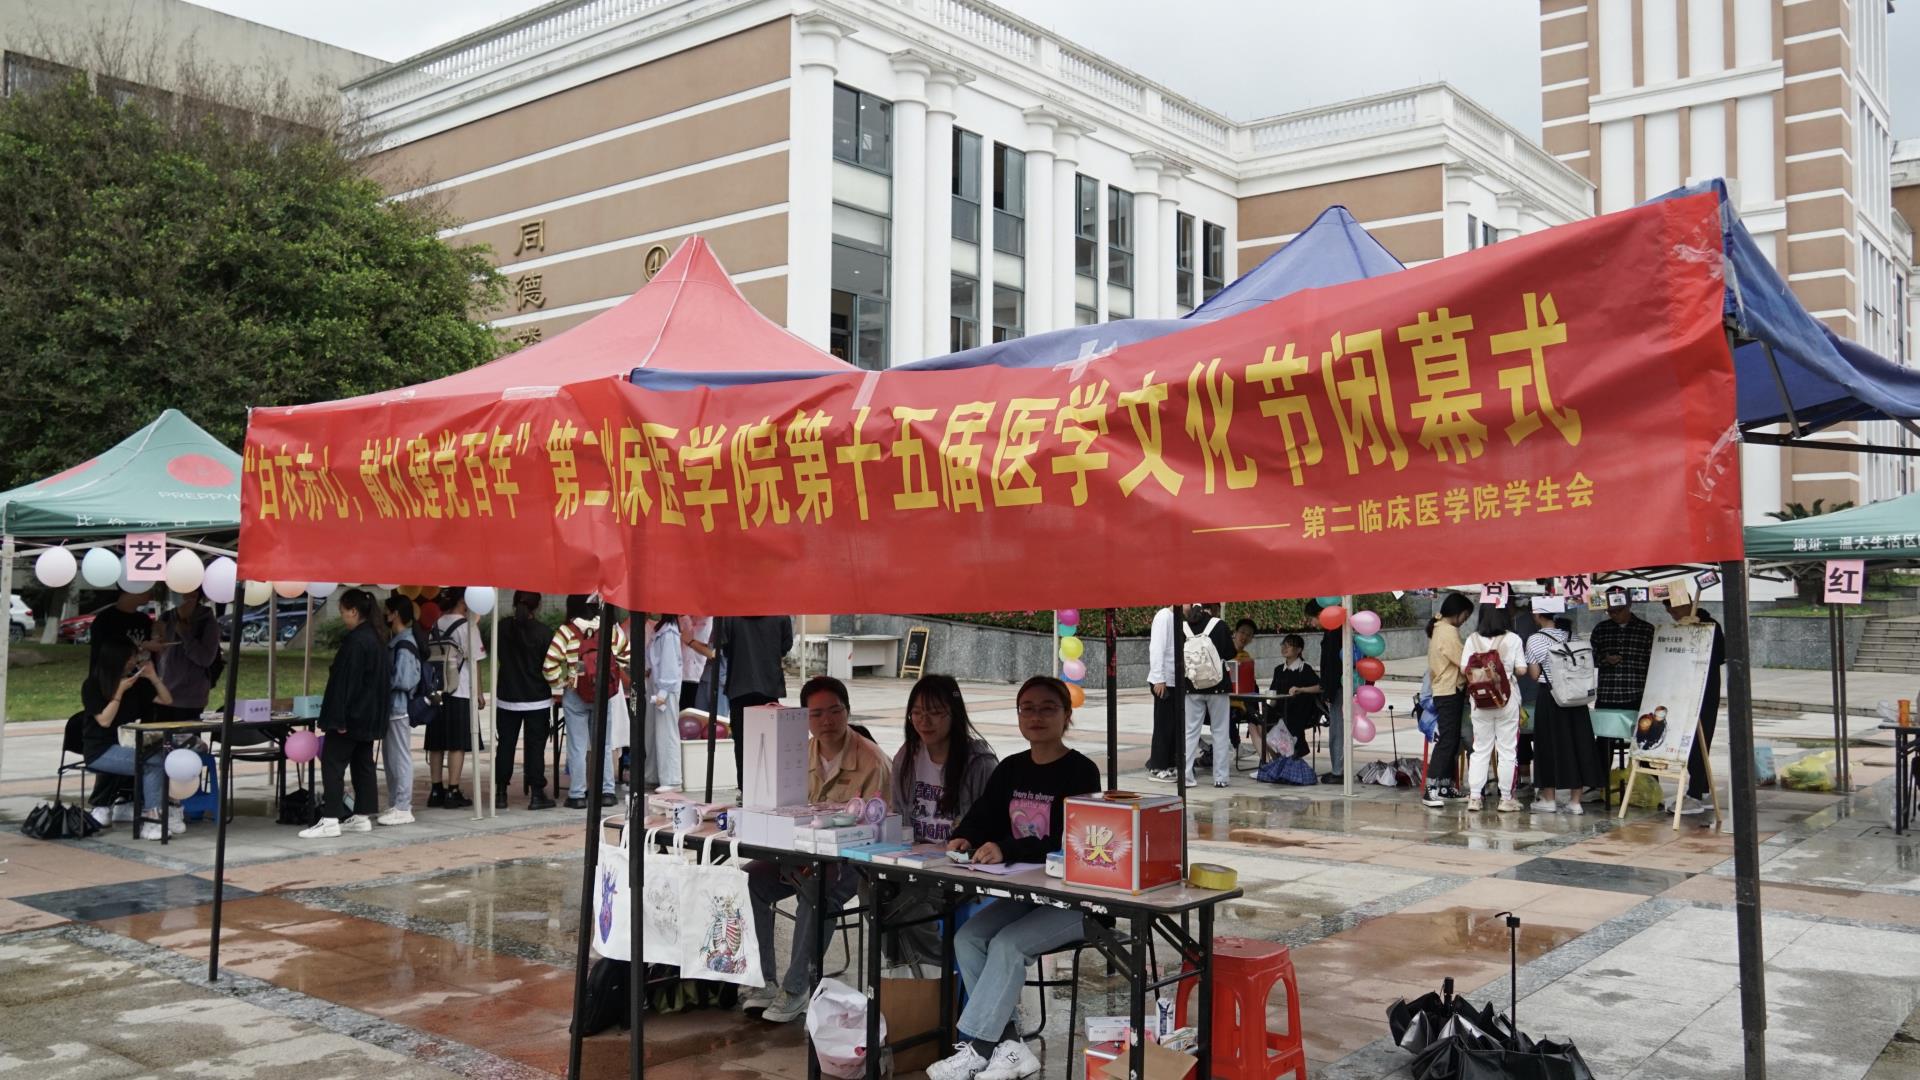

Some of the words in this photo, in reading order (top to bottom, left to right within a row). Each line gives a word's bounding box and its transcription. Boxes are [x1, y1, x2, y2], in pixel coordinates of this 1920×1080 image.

[129, 541, 162, 571] 艺
[1563, 574, 1589, 595] 林
[1828, 567, 1859, 594] 红
